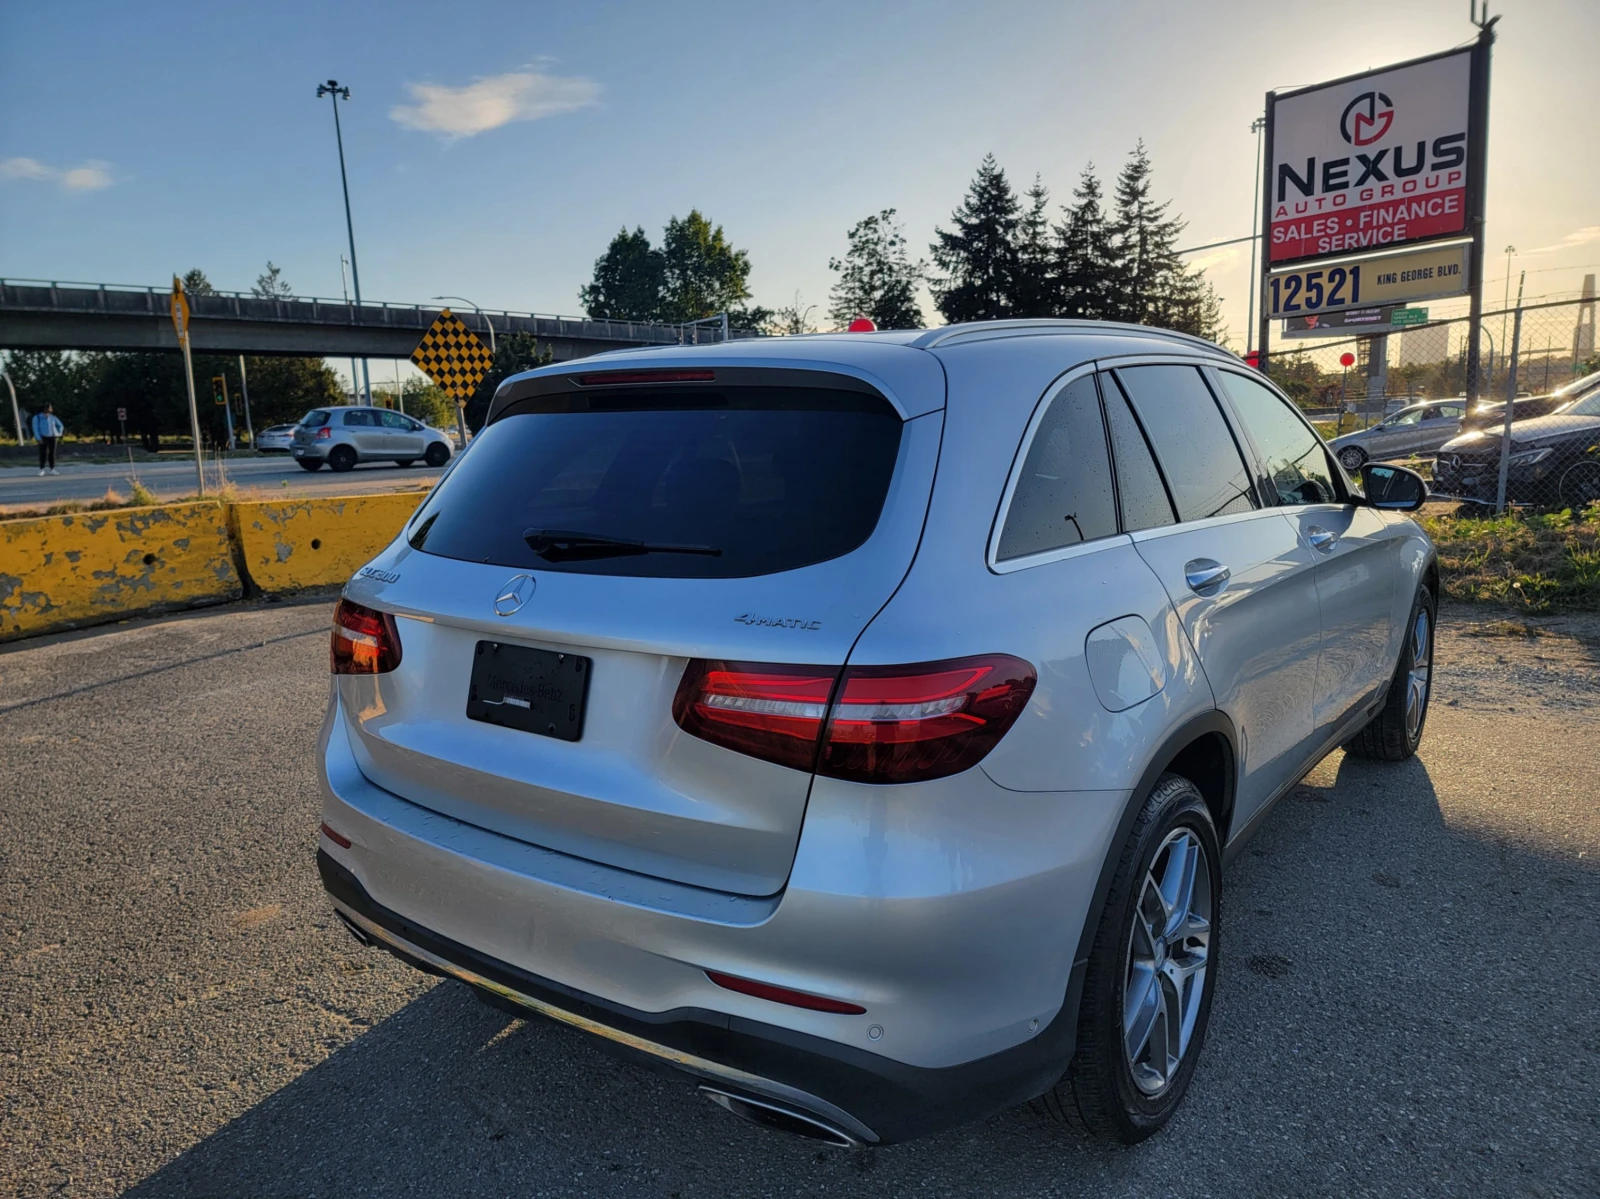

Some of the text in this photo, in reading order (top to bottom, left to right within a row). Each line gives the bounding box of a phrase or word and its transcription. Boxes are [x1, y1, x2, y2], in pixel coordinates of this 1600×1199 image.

[1277, 132, 1466, 202] NEXUS
[1275, 171, 1462, 218] AUTO GROUP
[1272, 194, 1459, 243] SALES FINANCE
[1318, 224, 1407, 254] SERVICE
[1270, 265, 1361, 314] 12521
[1377, 273, 1397, 286] KING
[1400, 267, 1434, 283] GEORGE
[1437, 264, 1462, 278] BLVD.
[734, 612, 822, 631] 4MATIC
[487, 674, 564, 701] Mercedes-Benz
